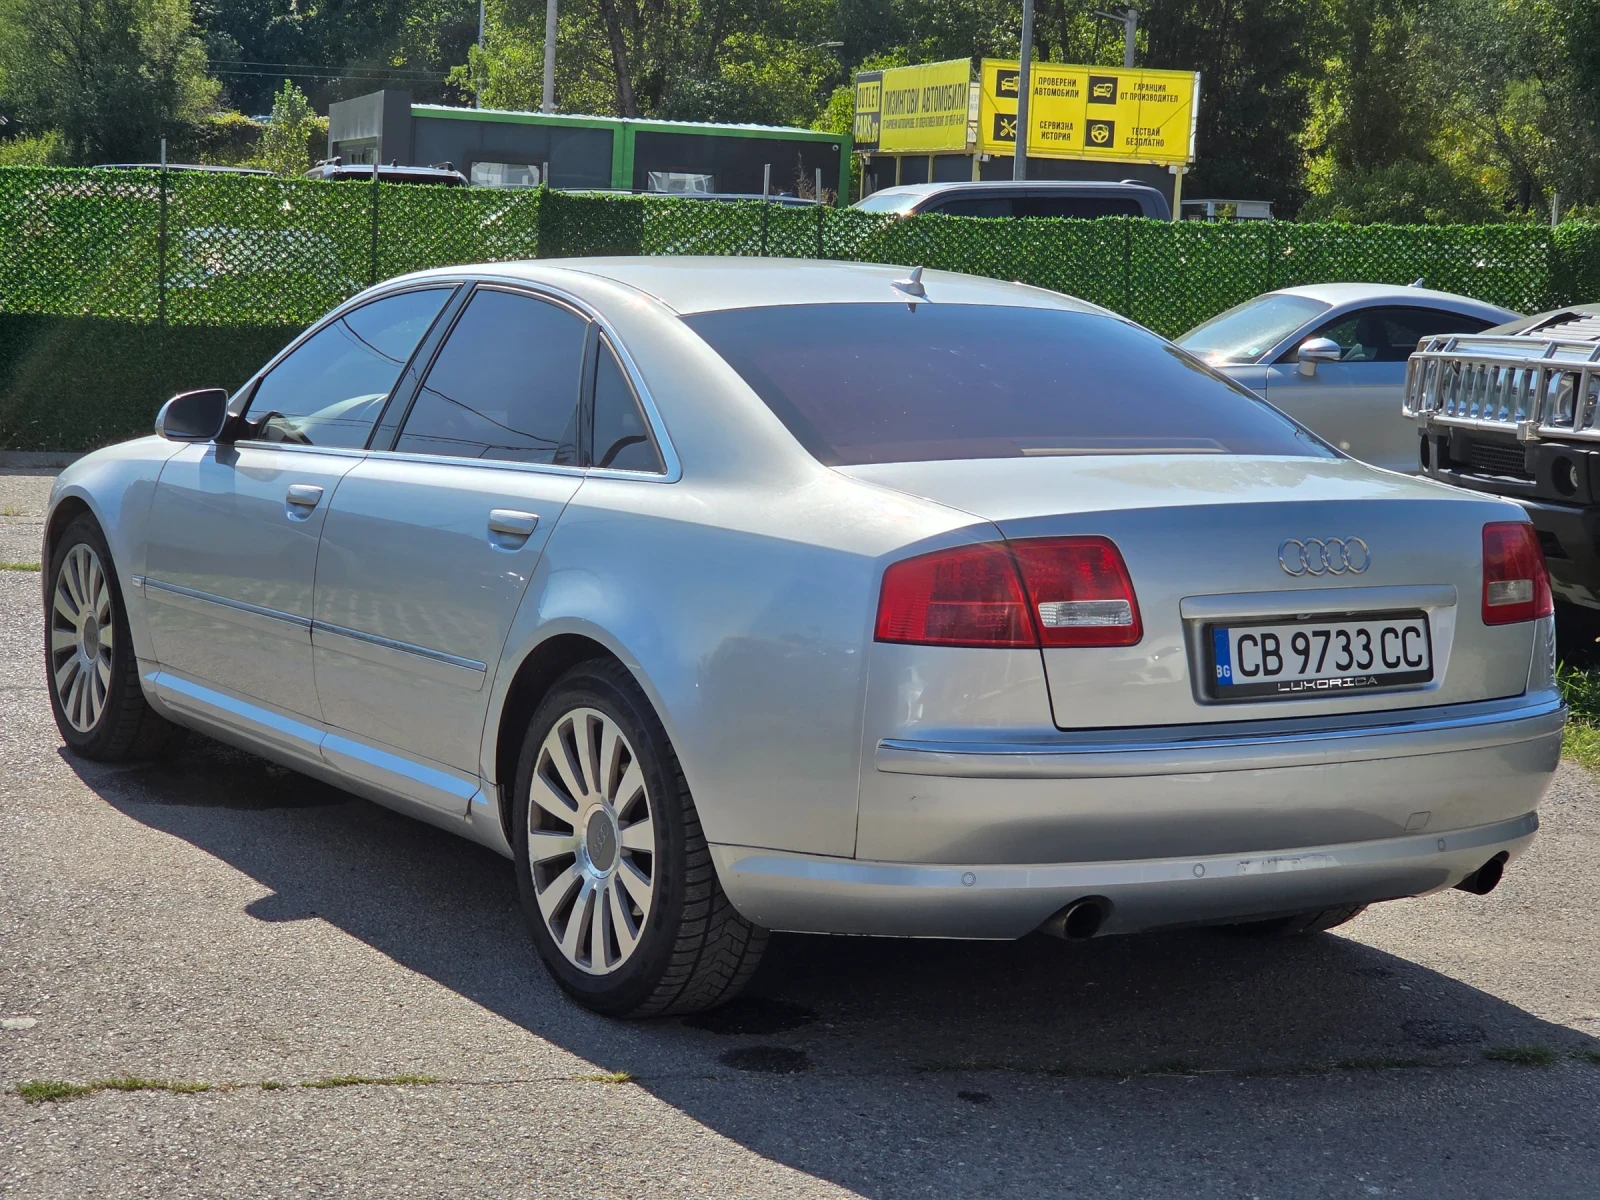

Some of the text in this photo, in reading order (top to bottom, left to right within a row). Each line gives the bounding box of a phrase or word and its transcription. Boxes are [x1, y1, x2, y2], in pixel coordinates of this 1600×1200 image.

[1038, 77, 1077, 87] ПРОВЕРЕНИ
[1034, 87, 1079, 98] АВТОМОБИЛИ
[1133, 83, 1167, 92] ГАРАНЦИЯ
[858, 86, 879, 108] OUTLET
[884, 83, 966, 115] ЛИЗИНГОВИ АВТОМОБИЛИ
[1129, 93, 1179, 103] ПРОИЗВОДИТЕЛ
[1039, 121, 1073, 131] СЕРВИЗНА
[1131, 126, 1161, 136] ТЕСТВАЙ
[1041, 131, 1071, 141] ИСТОРИЯ
[1125, 137, 1165, 147] БЕЗПЛАТНО
[1237, 626, 1423, 677] CB 9733 CC
[1216, 665, 1231, 678] BG
[1277, 676, 1378, 691] LUXORICA
